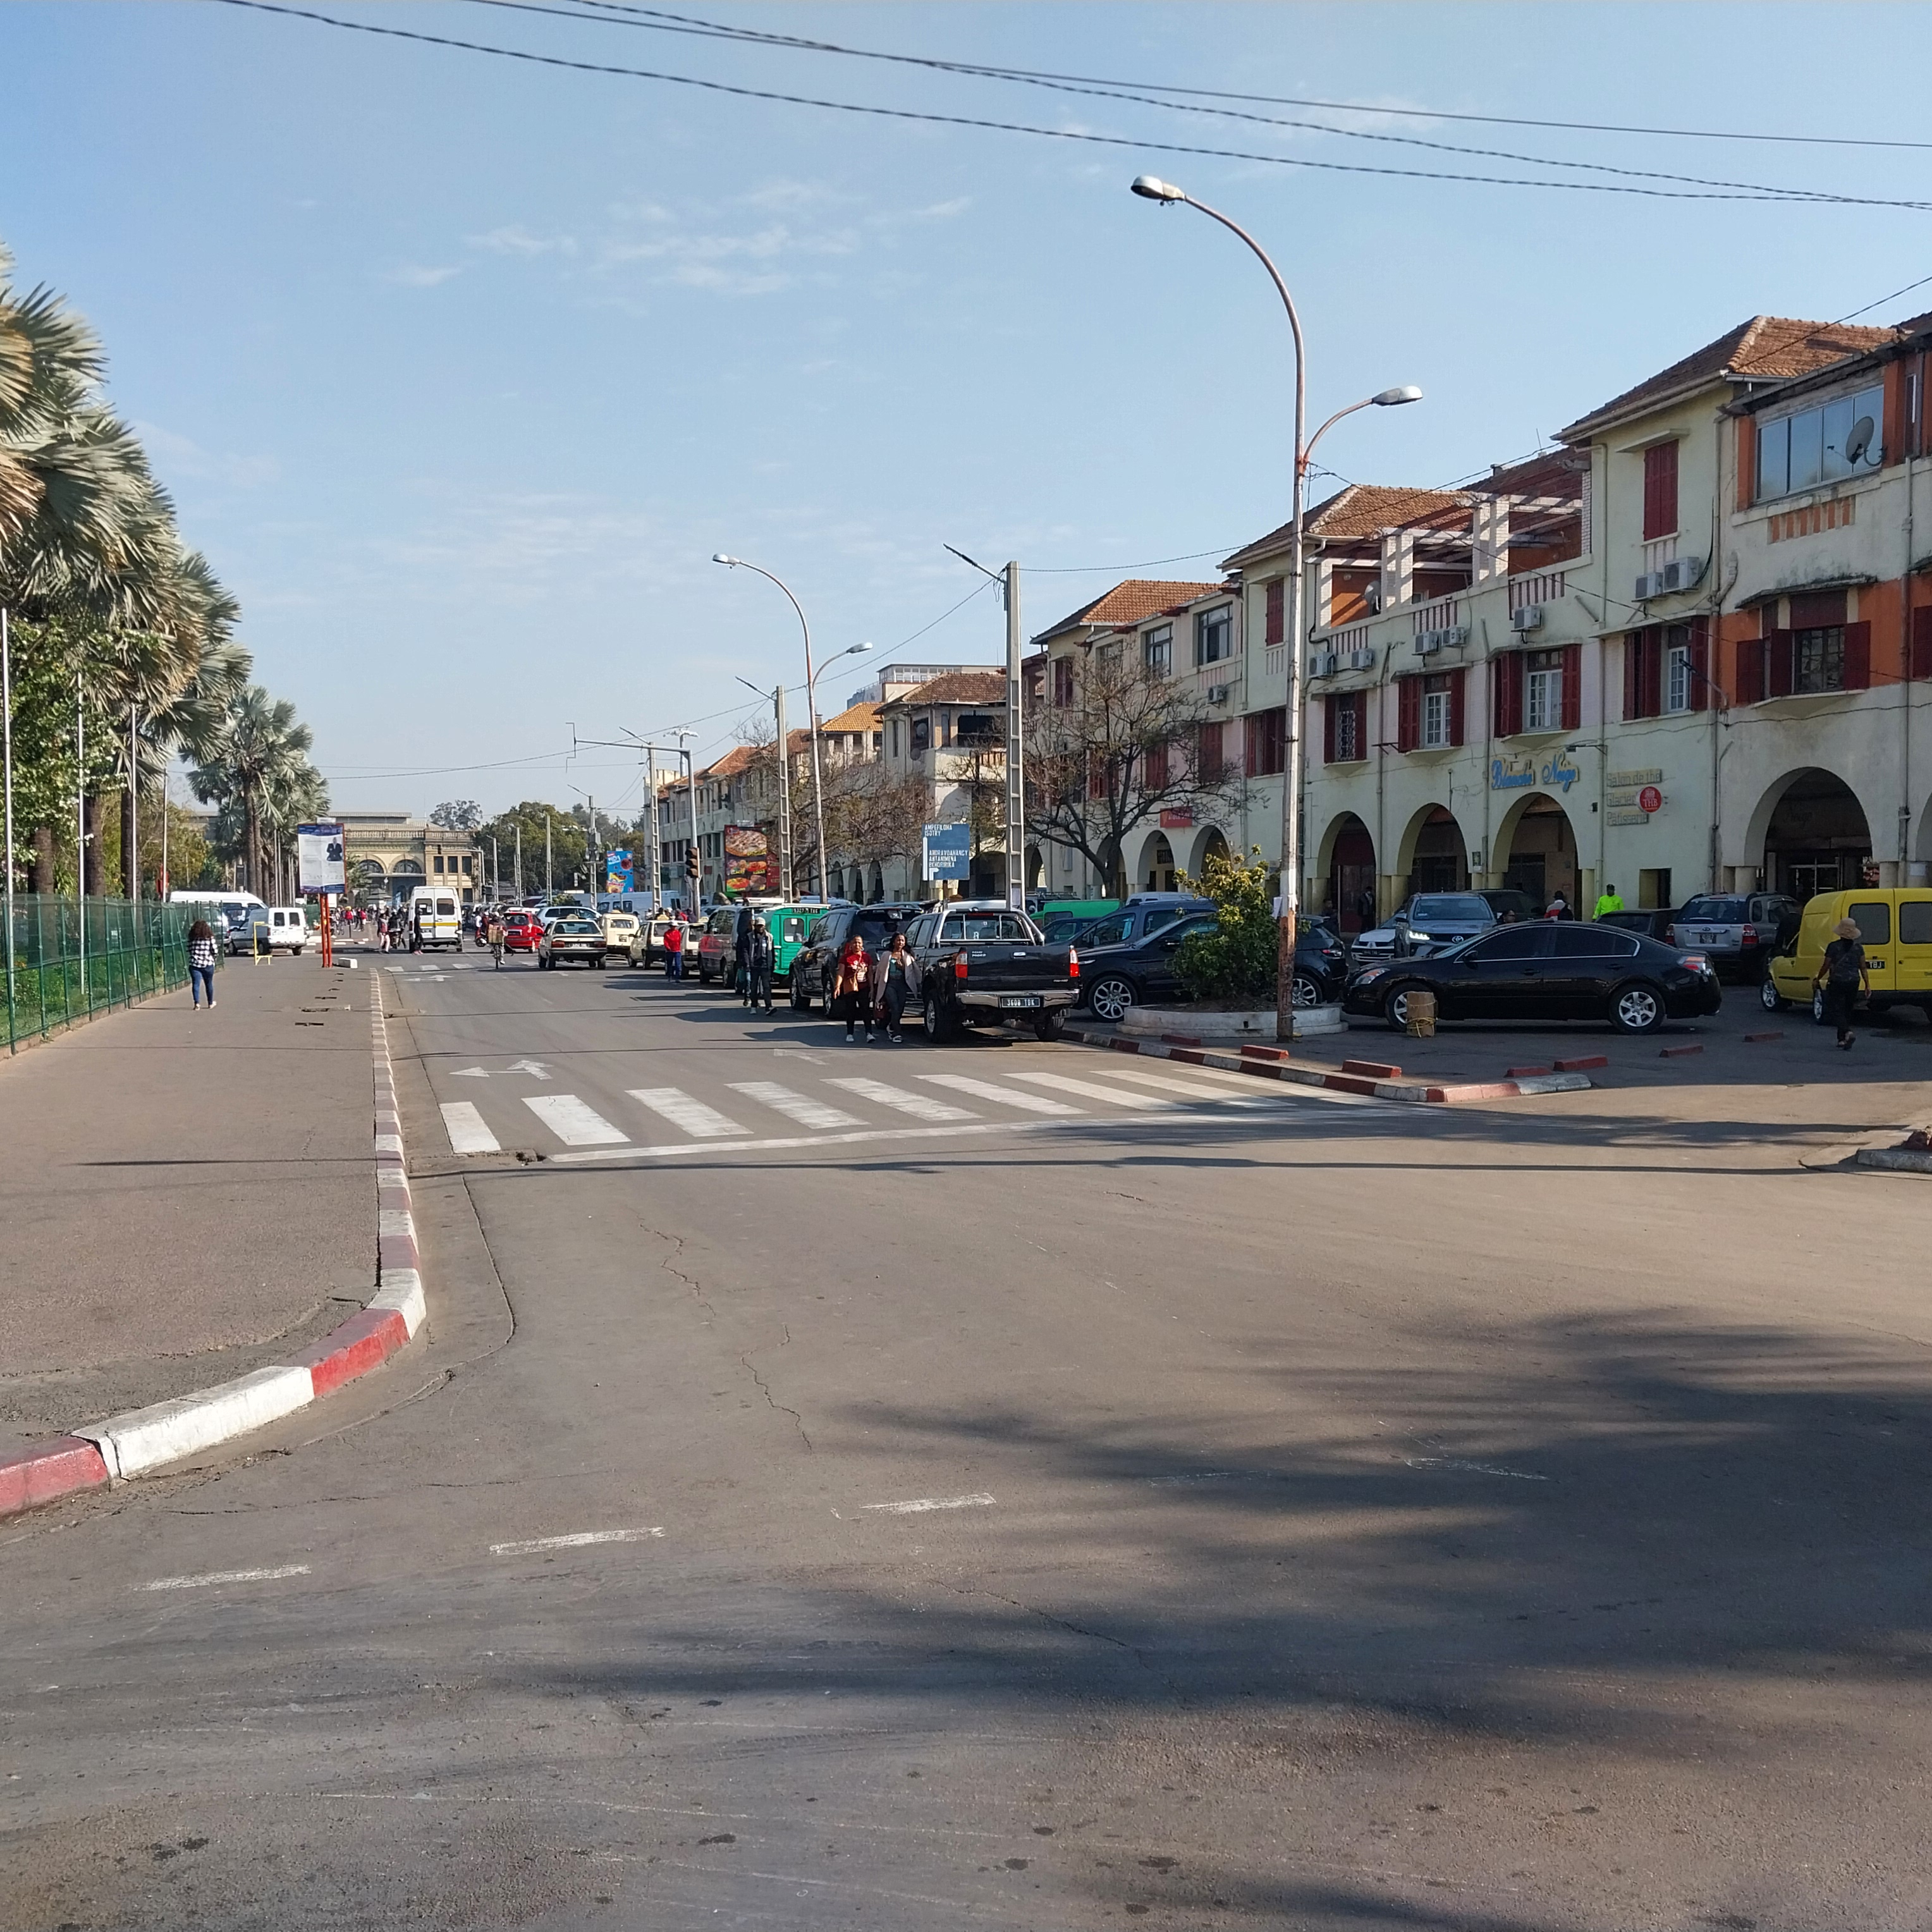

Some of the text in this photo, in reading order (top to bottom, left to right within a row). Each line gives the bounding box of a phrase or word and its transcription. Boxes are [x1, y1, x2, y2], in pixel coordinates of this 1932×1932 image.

[1606, 772, 1630, 787] Salon
[1633, 771, 1644, 785] de
[1643, 798, 1658, 807] THB
